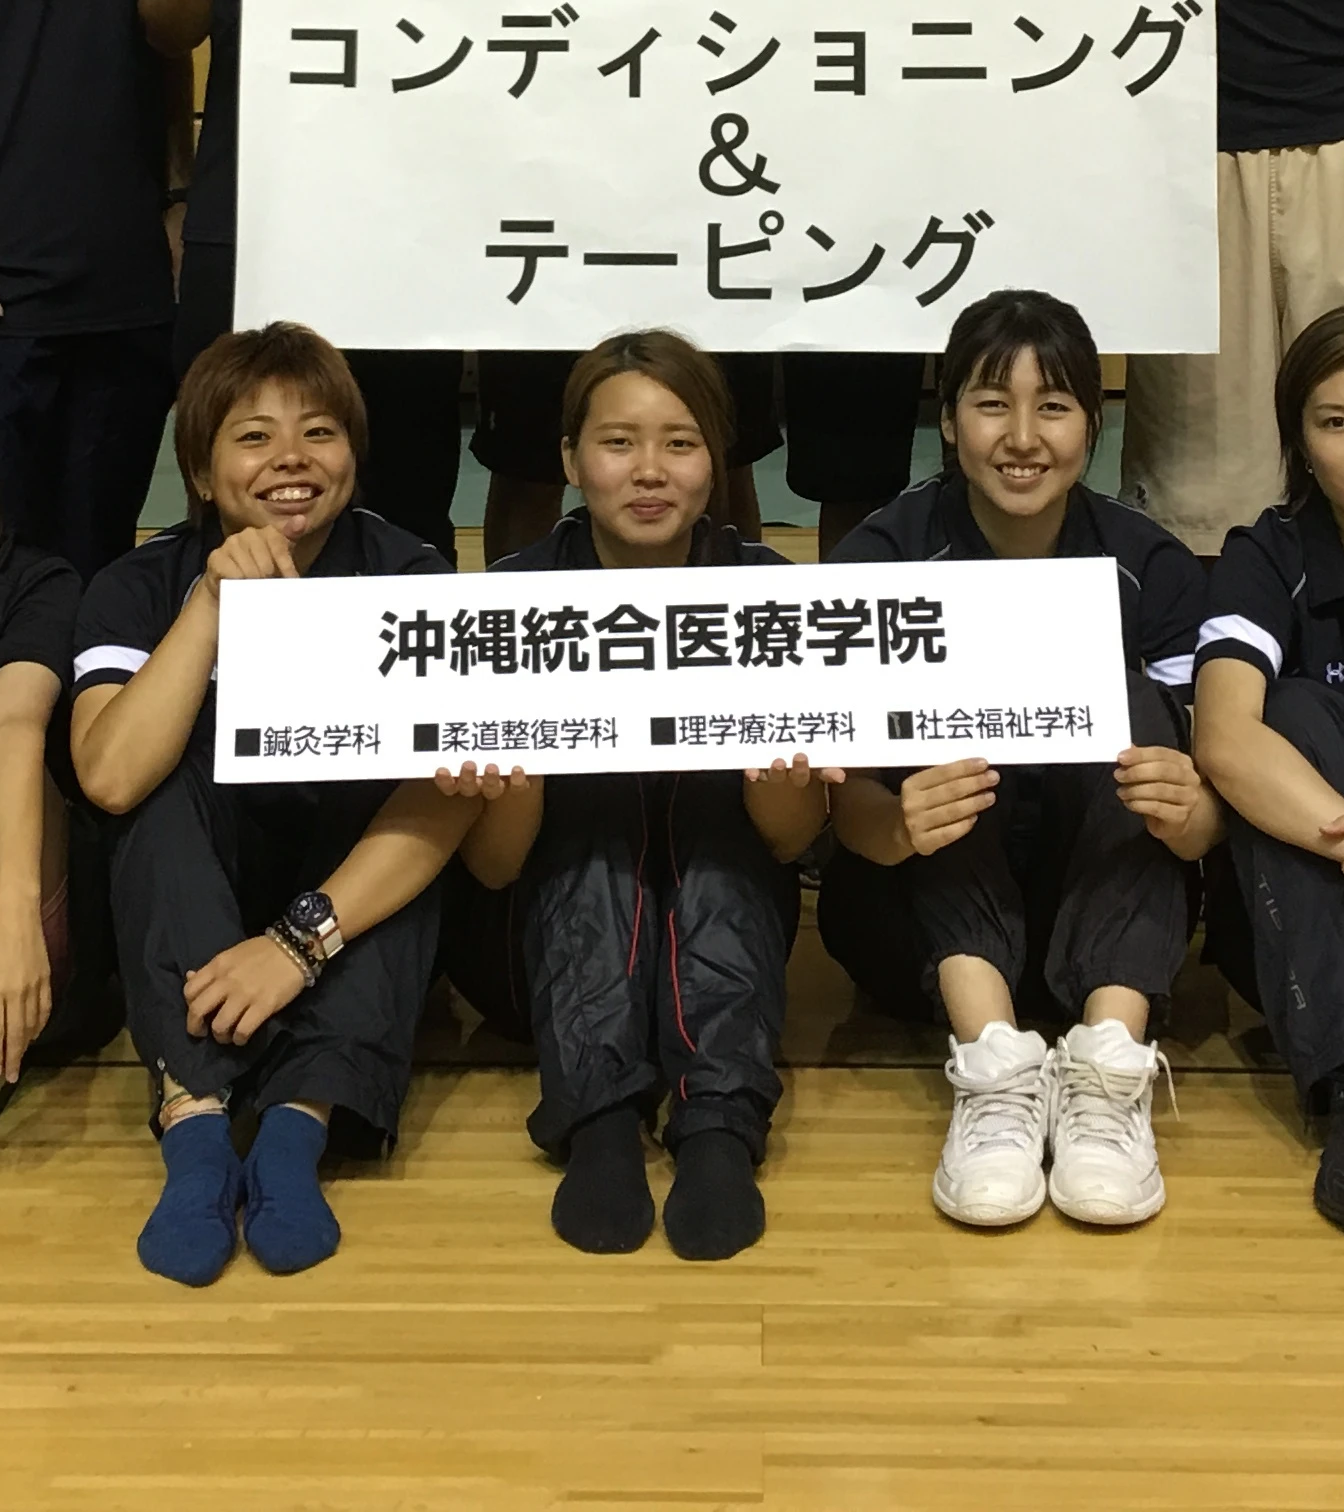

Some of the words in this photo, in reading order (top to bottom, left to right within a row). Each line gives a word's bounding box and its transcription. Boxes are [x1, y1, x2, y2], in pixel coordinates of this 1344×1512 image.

[698, 113, 781, 197] &
[485, 209, 995, 307] テーピング
[378, 596, 947, 677] 沖縄統合医療学院
[441, 717, 619, 752] 柔道整復学科
[677, 711, 856, 746] 理学療法学科
[915, 705, 1094, 740] 社会福祉学科
